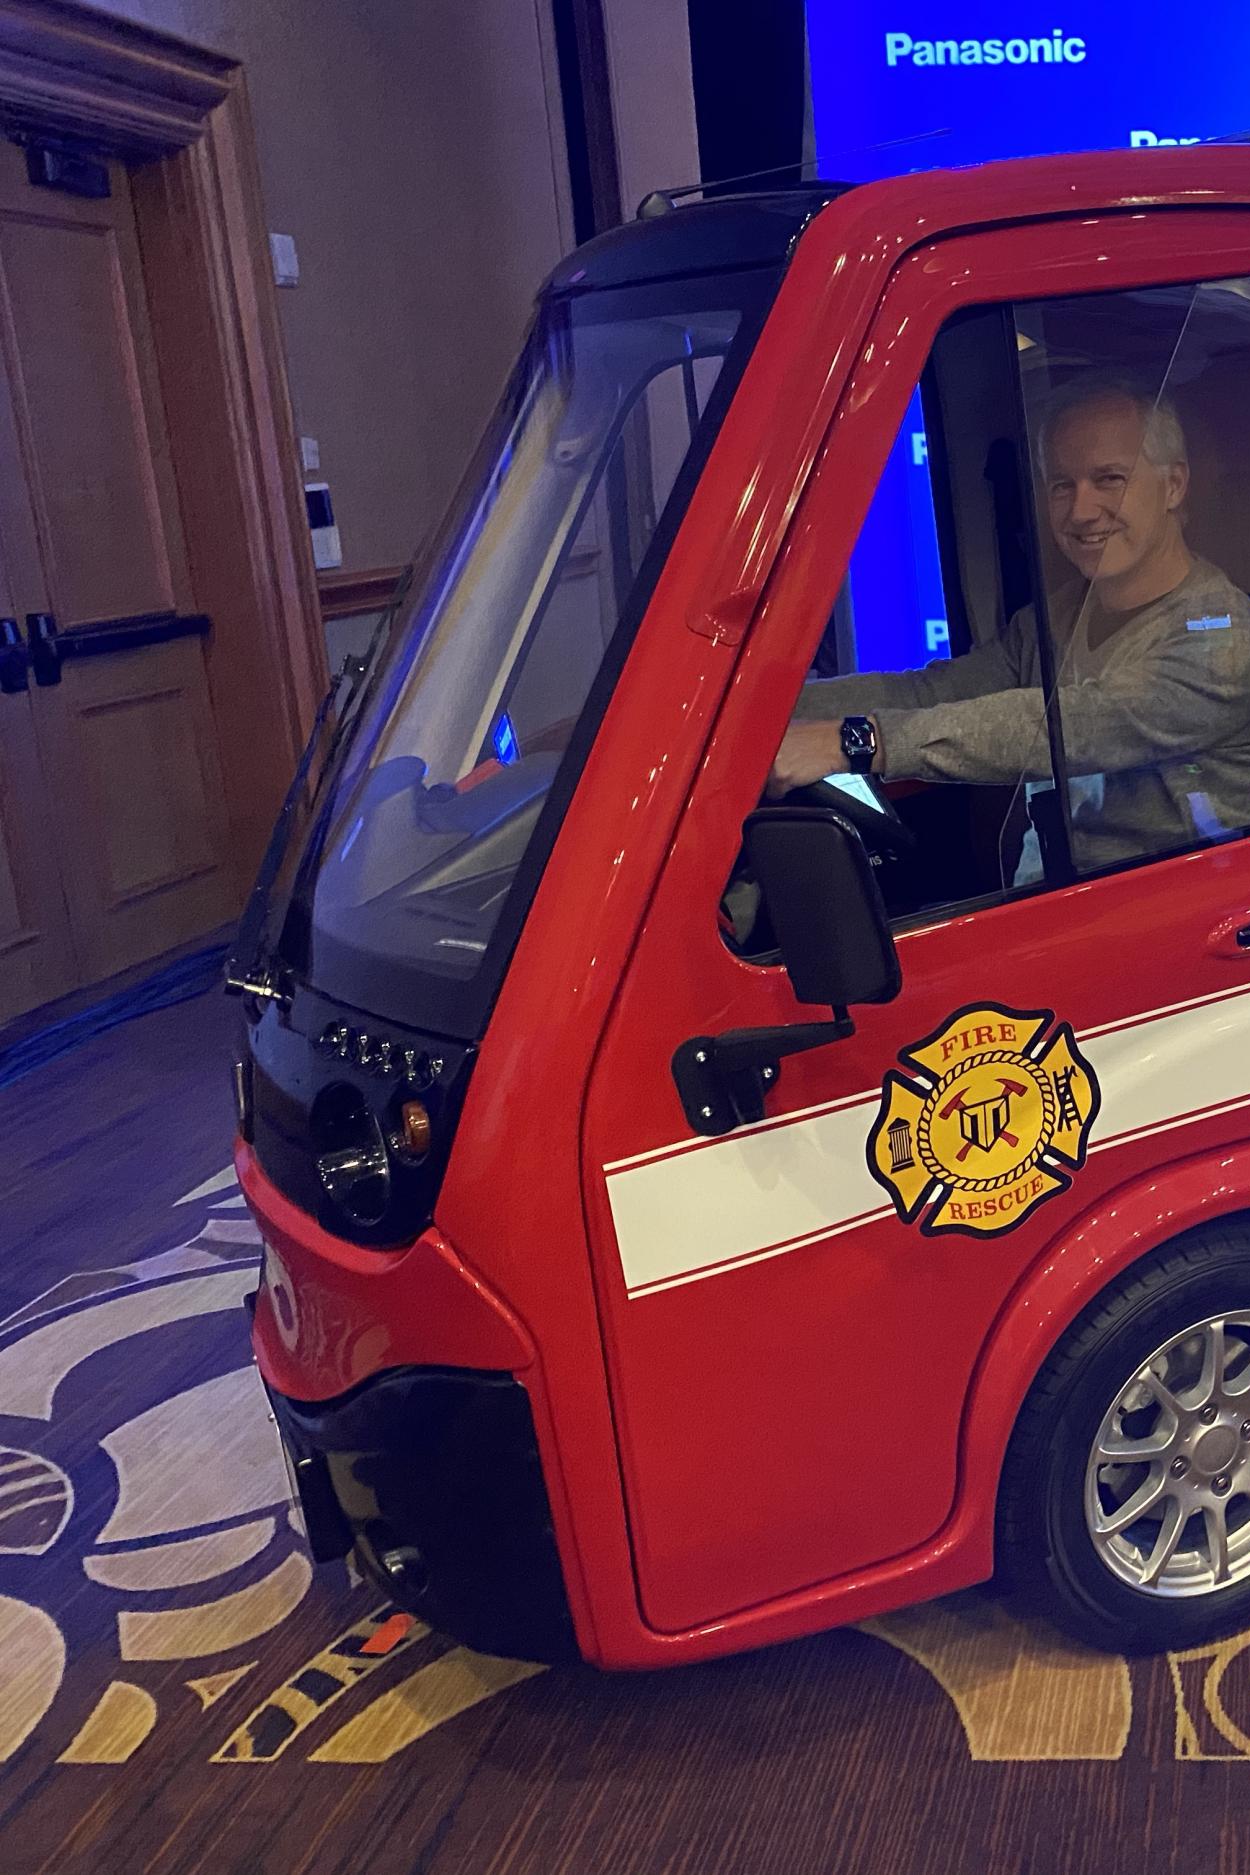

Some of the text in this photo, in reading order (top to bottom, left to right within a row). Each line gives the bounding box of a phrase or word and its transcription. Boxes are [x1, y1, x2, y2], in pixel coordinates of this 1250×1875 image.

[885, 28, 1086, 66] Panasonic
[940, 1023, 1017, 1062] FIRE
[948, 1174, 1044, 1221] RESCUE
